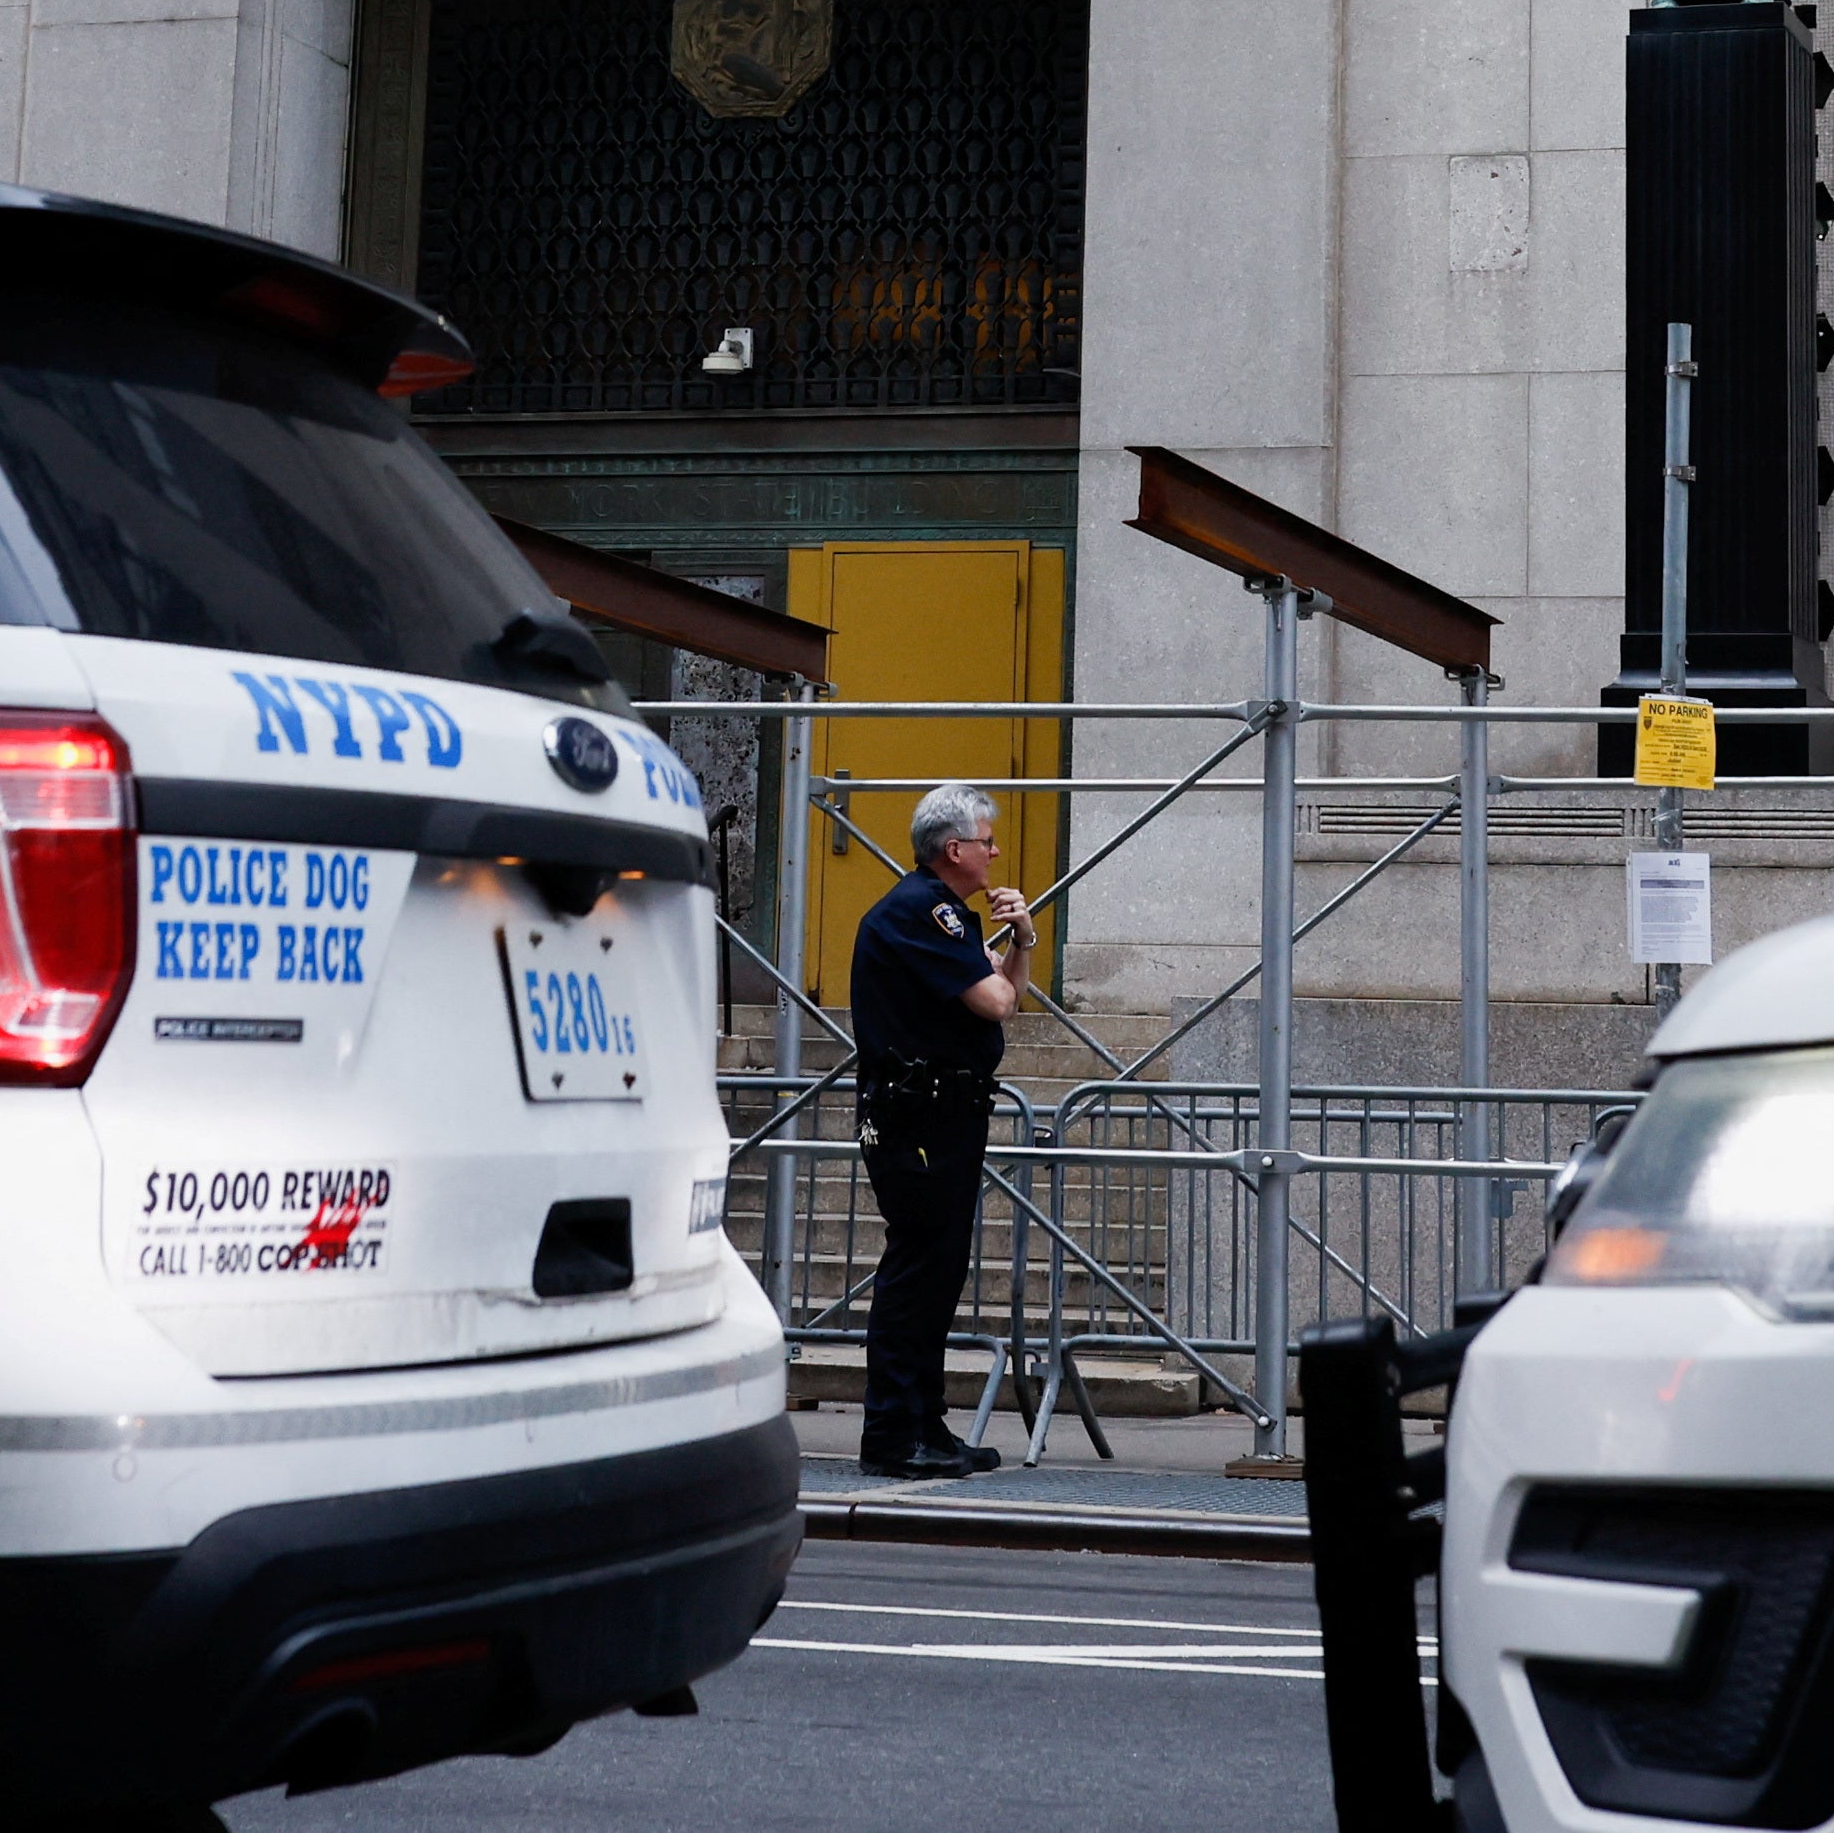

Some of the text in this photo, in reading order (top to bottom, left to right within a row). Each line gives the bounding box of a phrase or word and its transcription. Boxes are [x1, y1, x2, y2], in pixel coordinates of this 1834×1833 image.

[230, 670, 464, 768] NYPD
[1648, 703, 1708, 720] NO PARKING
[149, 844, 369, 913] POLICE DOG
[154, 920, 364, 984] KEEP BACK
[142, 1167, 391, 1222] $10,000 REWARD
[139, 1244, 188, 1276] CALL
